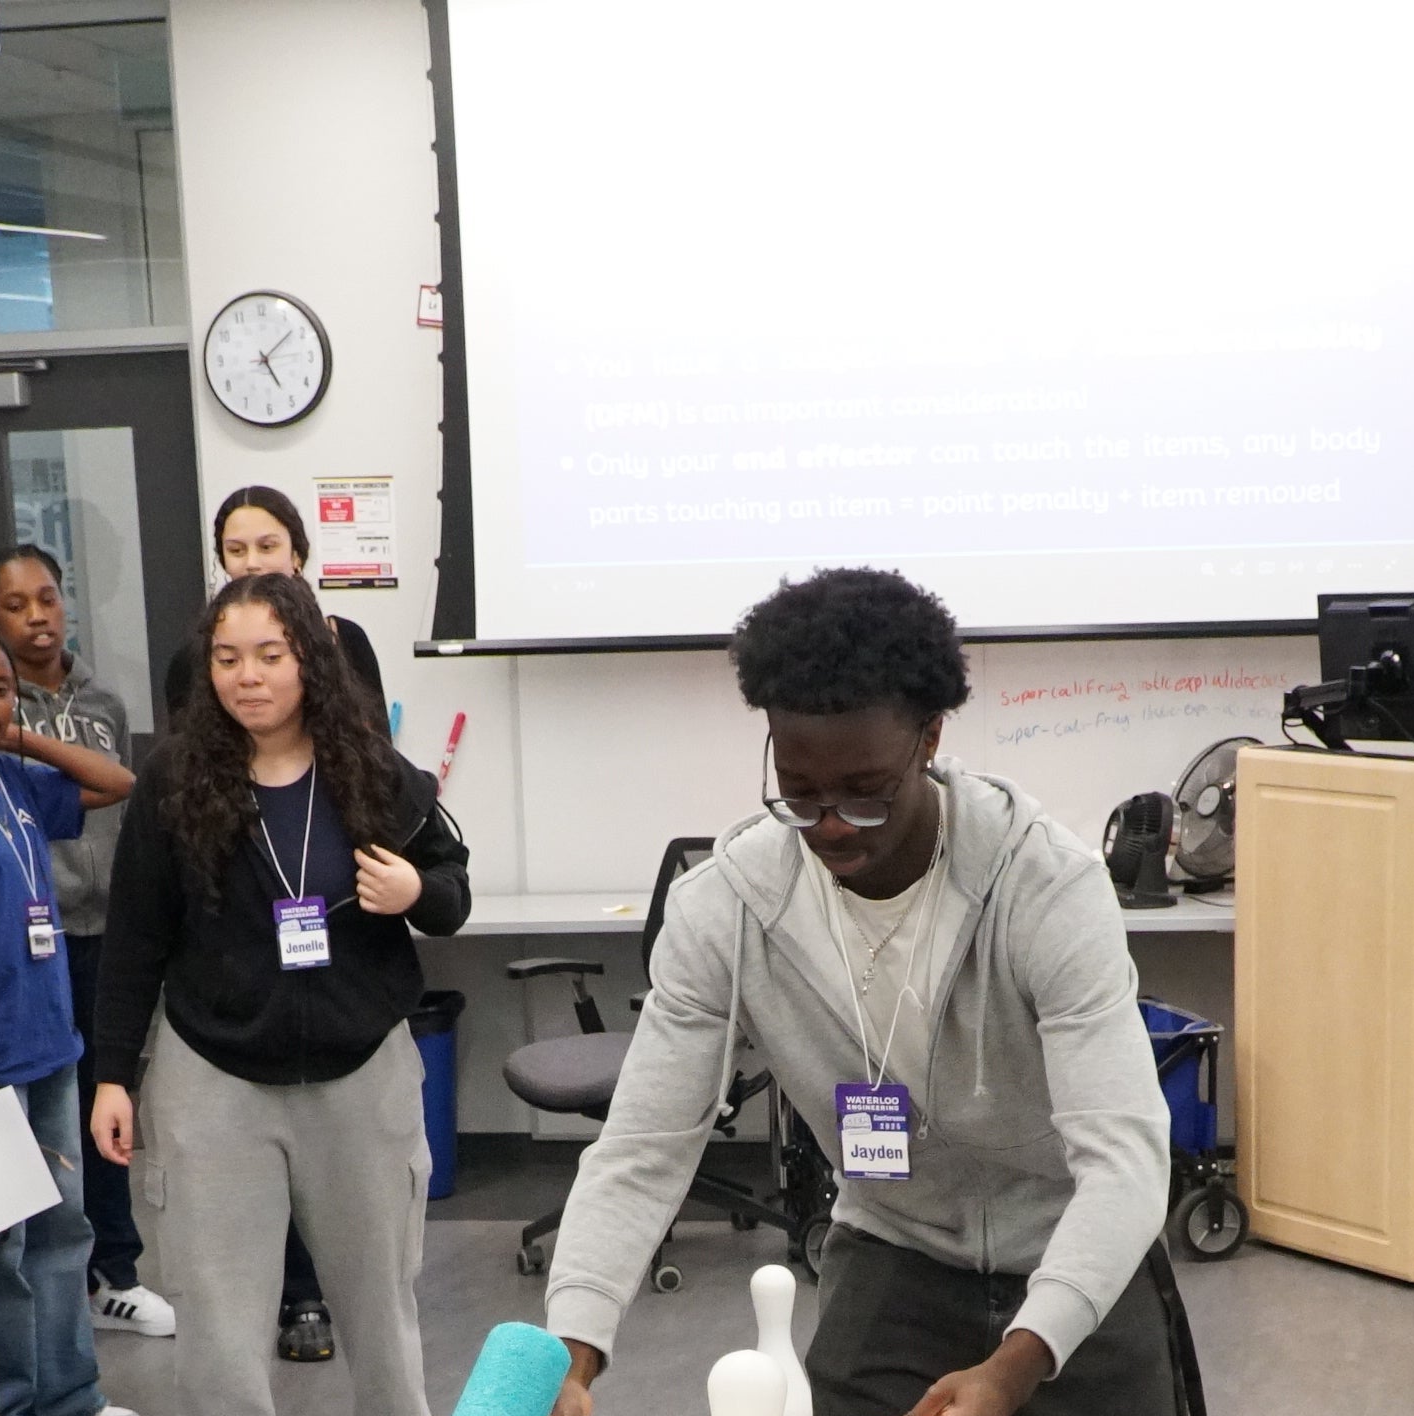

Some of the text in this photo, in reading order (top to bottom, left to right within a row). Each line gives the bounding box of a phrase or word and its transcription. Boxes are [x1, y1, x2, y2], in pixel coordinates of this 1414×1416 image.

[676, 400, 697, 424] is
[703, 404, 739, 424] an
[744, 394, 884, 424] important
[587, 426, 1381, 479] Only your end effector can touch the items, any body
[589, 502, 659, 529] parts
[665, 497, 782, 524] touching
[788, 499, 822, 519] an
[829, 493, 893, 517] item
[923, 489, 994, 518] point
[1002, 487, 1110, 517] penalty
[1142, 482, 1207, 508] item
[1213, 478, 1342, 506] removed
[286, 940, 325, 954] Jenelle
[845, 1095, 900, 1105] WATERLOO
[850, 1144, 903, 1161] Jayden
